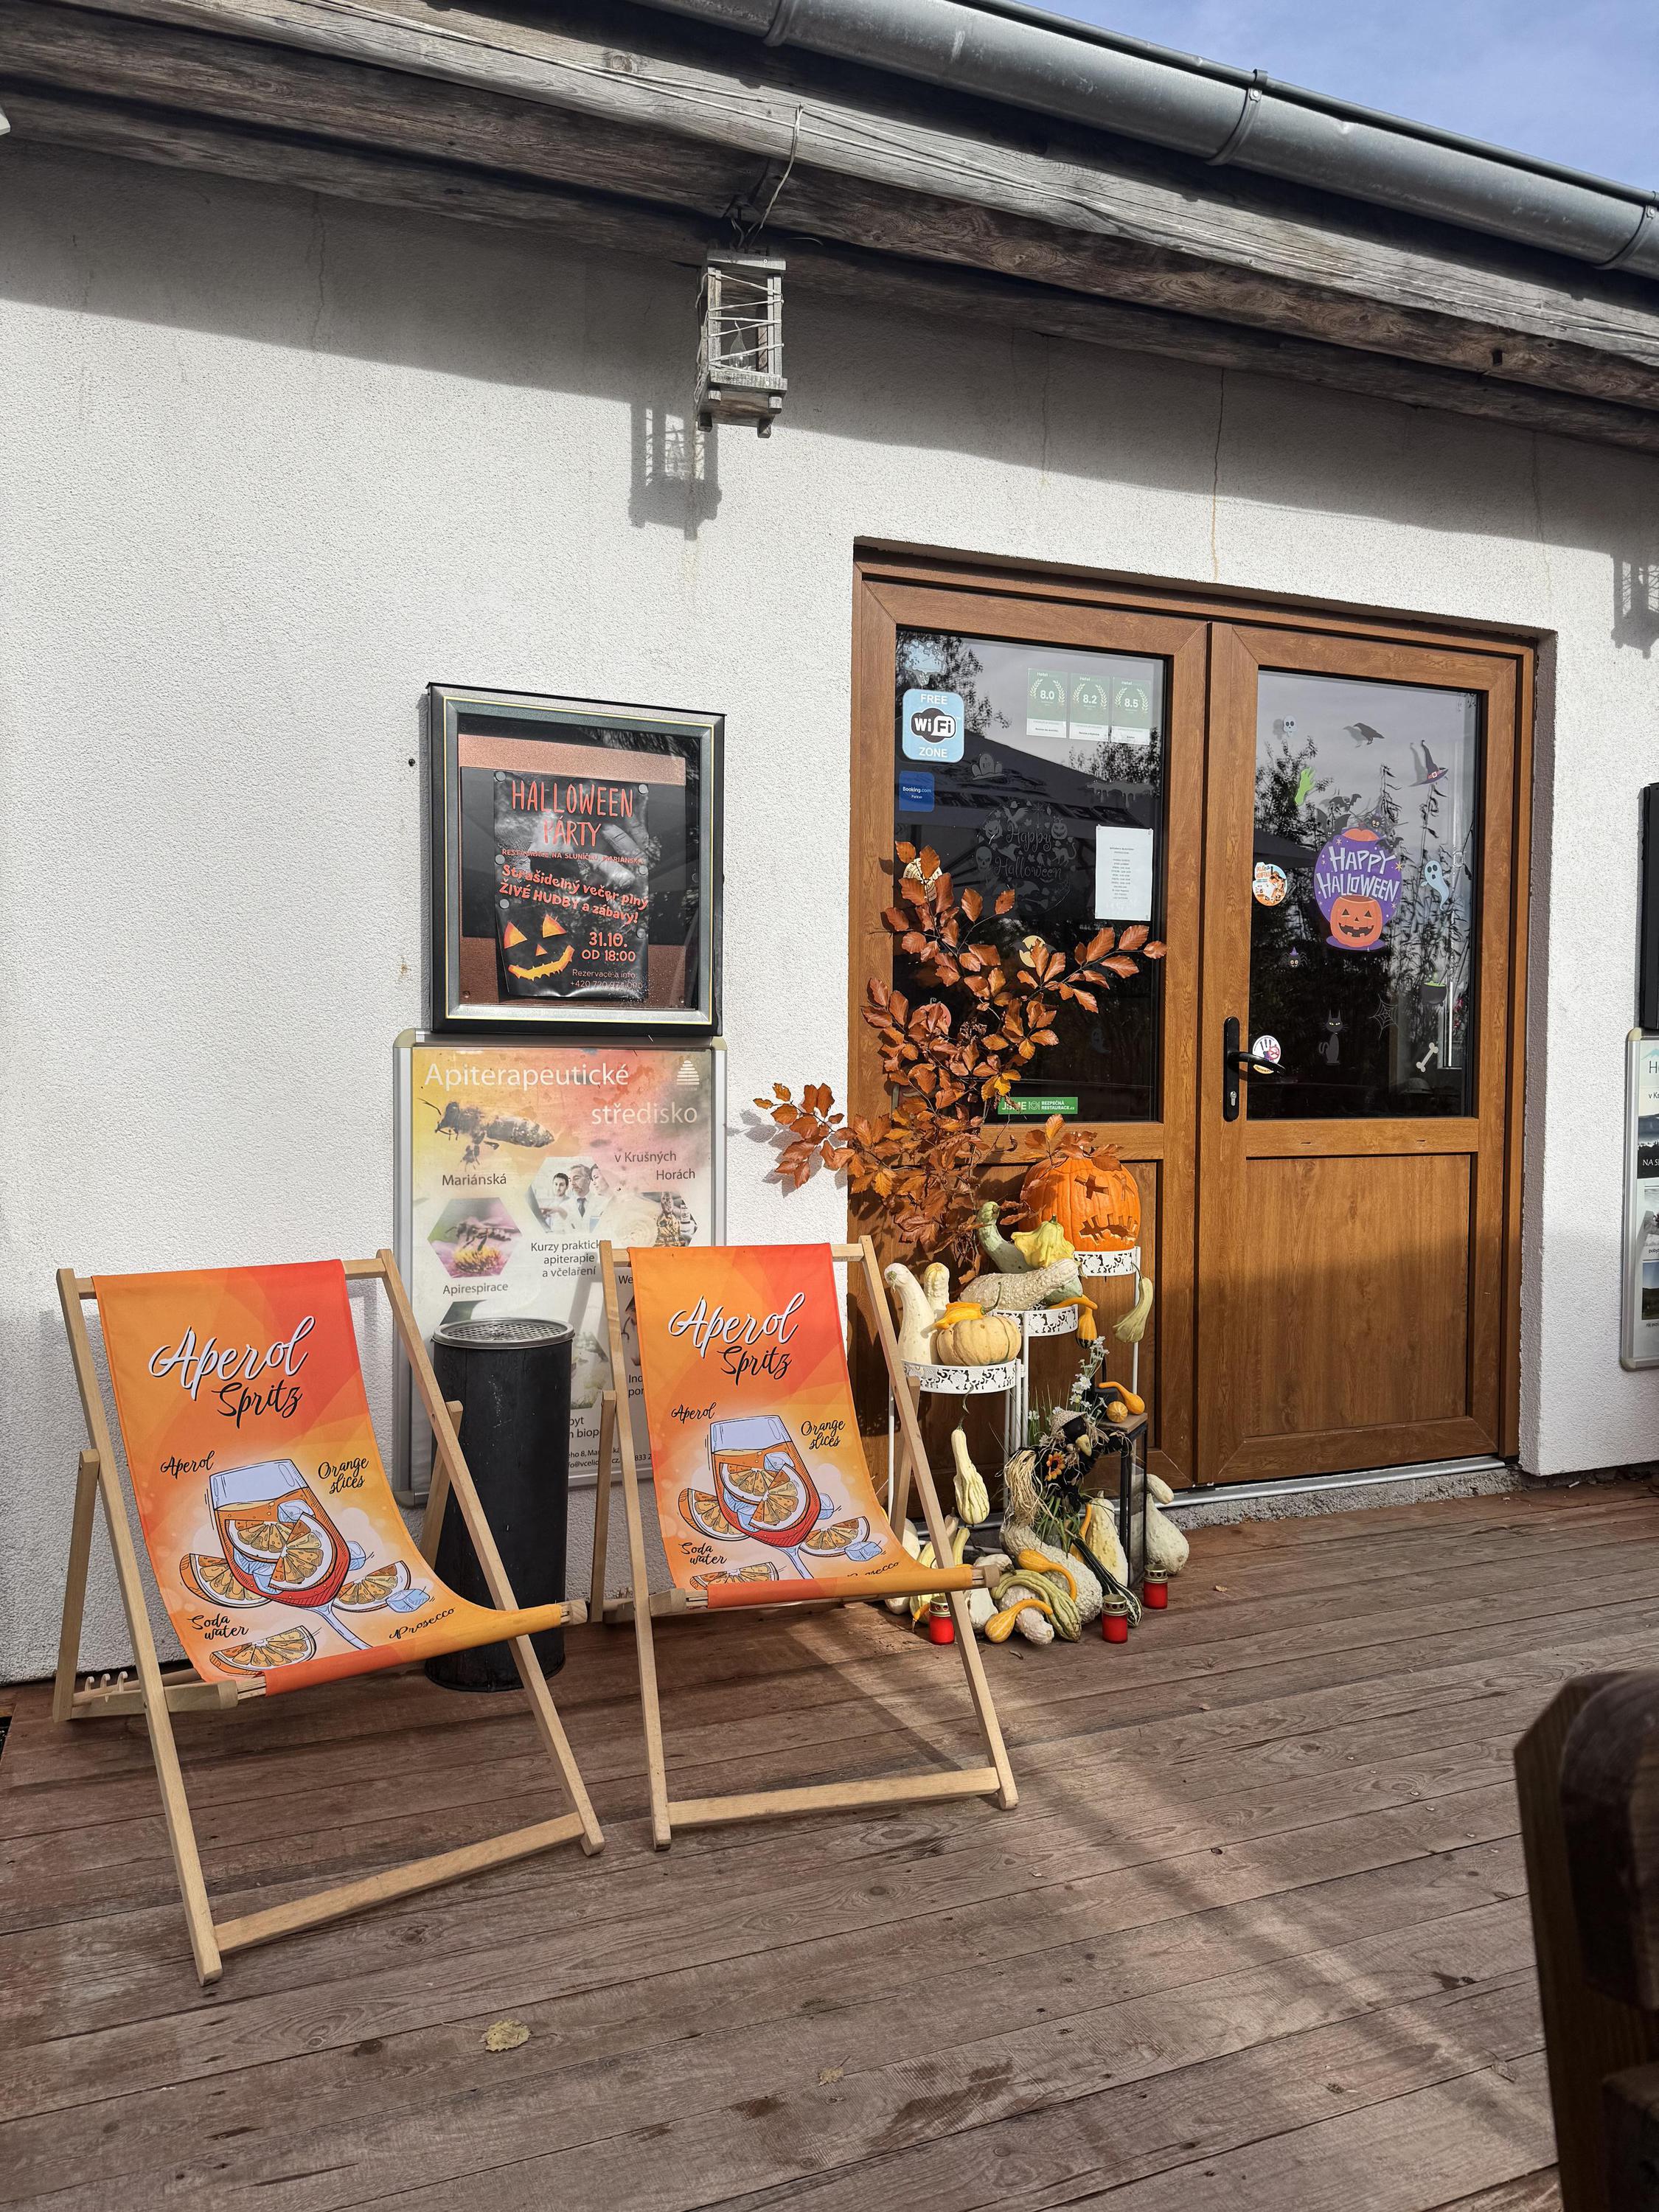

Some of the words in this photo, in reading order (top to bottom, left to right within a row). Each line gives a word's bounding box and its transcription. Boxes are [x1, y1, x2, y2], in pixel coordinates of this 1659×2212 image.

[920, 694, 947, 705] FREE
[1040, 690, 1054, 700] 8.0
[1082, 695, 1097, 704] 8.2
[1124, 698, 1138, 708] 8.5
[914, 717, 951, 734] WiFi
[919, 747, 947, 758] ZONE
[512, 780, 633, 818] HALLOWEEN
[543, 815, 602, 847] PÁRTY
[1006, 822, 1051, 852] Happy
[994, 856, 1062, 880] Halloween
[1329, 846, 1397, 874] HAPPY
[502, 863, 580, 895] Strašidelný
[582, 885, 619, 902] večer
[621, 894, 649, 911] plný
[1316, 873, 1400, 902] HALLOWEEN
[499, 878, 531, 899] ŽIVÉ
[533, 890, 580, 910] HUDBY
[582, 902, 590, 912] a
[592, 904, 639, 925] zábavy!
[589, 931, 628, 948] 31.10.
[581, 949, 600, 960] OD
[605, 950, 636, 962] 18:00
[572, 969, 612, 978] Rezervace
[593, 981, 608, 989] 720
[425, 1062, 629, 1091] Apiterapeutické
[591, 1102, 698, 1124] středisko
[615, 1154, 622, 1163] v
[624, 1150, 677, 1165] Krušných
[442, 1173, 507, 1186] Mariánská
[655, 1168, 695, 1180] Horách
[531, 1242, 559, 1253] Kurzy
[543, 1254, 595, 1266] apiterapie
[551, 1266, 596, 1277] včelaření
[442, 1283, 509, 1296] Apirespirace
[668, 1292, 805, 1358] Aperol
[148, 1315, 316, 1401] Aperol
[717, 1345, 793, 1386] Spritz
[212, 1380, 303, 1429] Spritz
[671, 1402, 717, 1425] Aperol
[800, 1419, 846, 1437] Orange
[809, 1433, 841, 1451] slices
[160, 1450, 215, 1480] Aperol
[318, 1456, 369, 1480] Orange
[329, 1473, 365, 1495] slices
[678, 1542, 713, 1556] Soda
[689, 1551, 727, 1565] water
[190, 1613, 231, 1631] Soda
[389, 1607, 456, 1641] Prosecco
[204, 1624, 248, 1641] water
